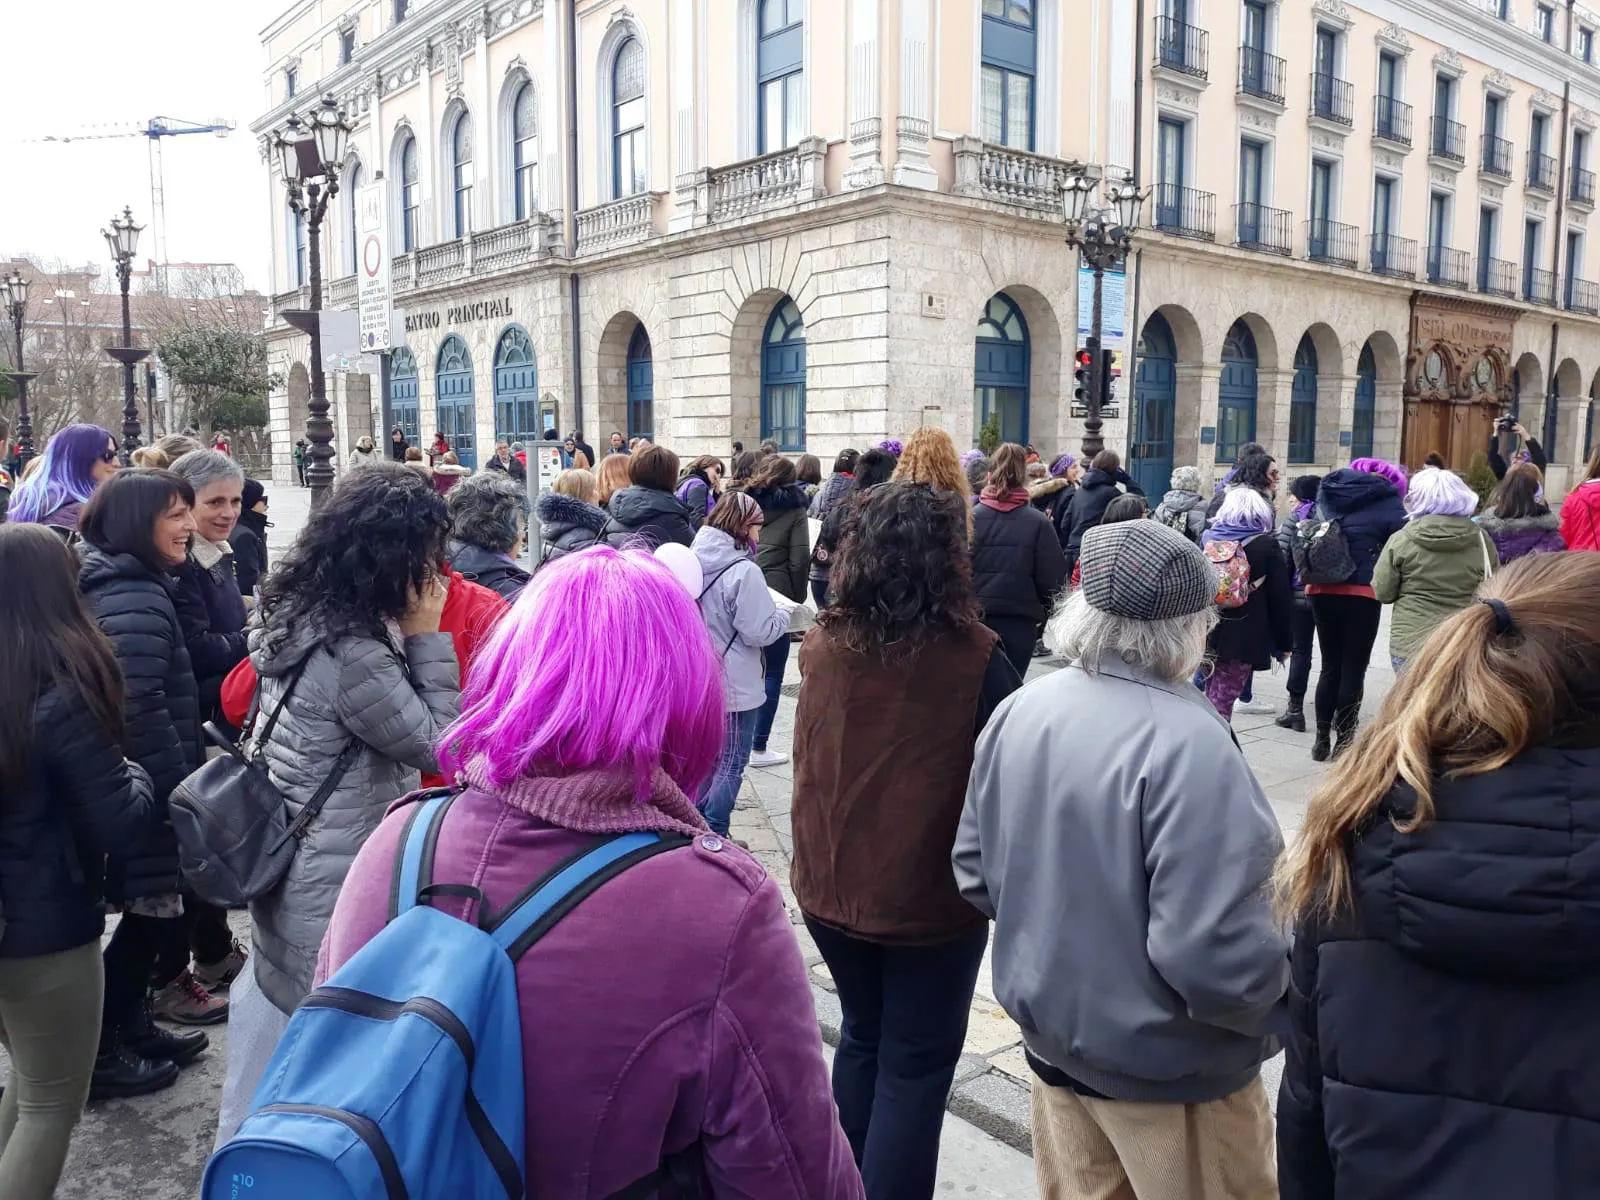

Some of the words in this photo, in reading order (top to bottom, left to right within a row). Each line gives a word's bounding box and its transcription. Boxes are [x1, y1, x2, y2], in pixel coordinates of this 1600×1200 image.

[405, 311, 440, 333] EATRO
[447, 297, 513, 325] PRINCIPAL
[240, 1172, 254, 1188] 10
